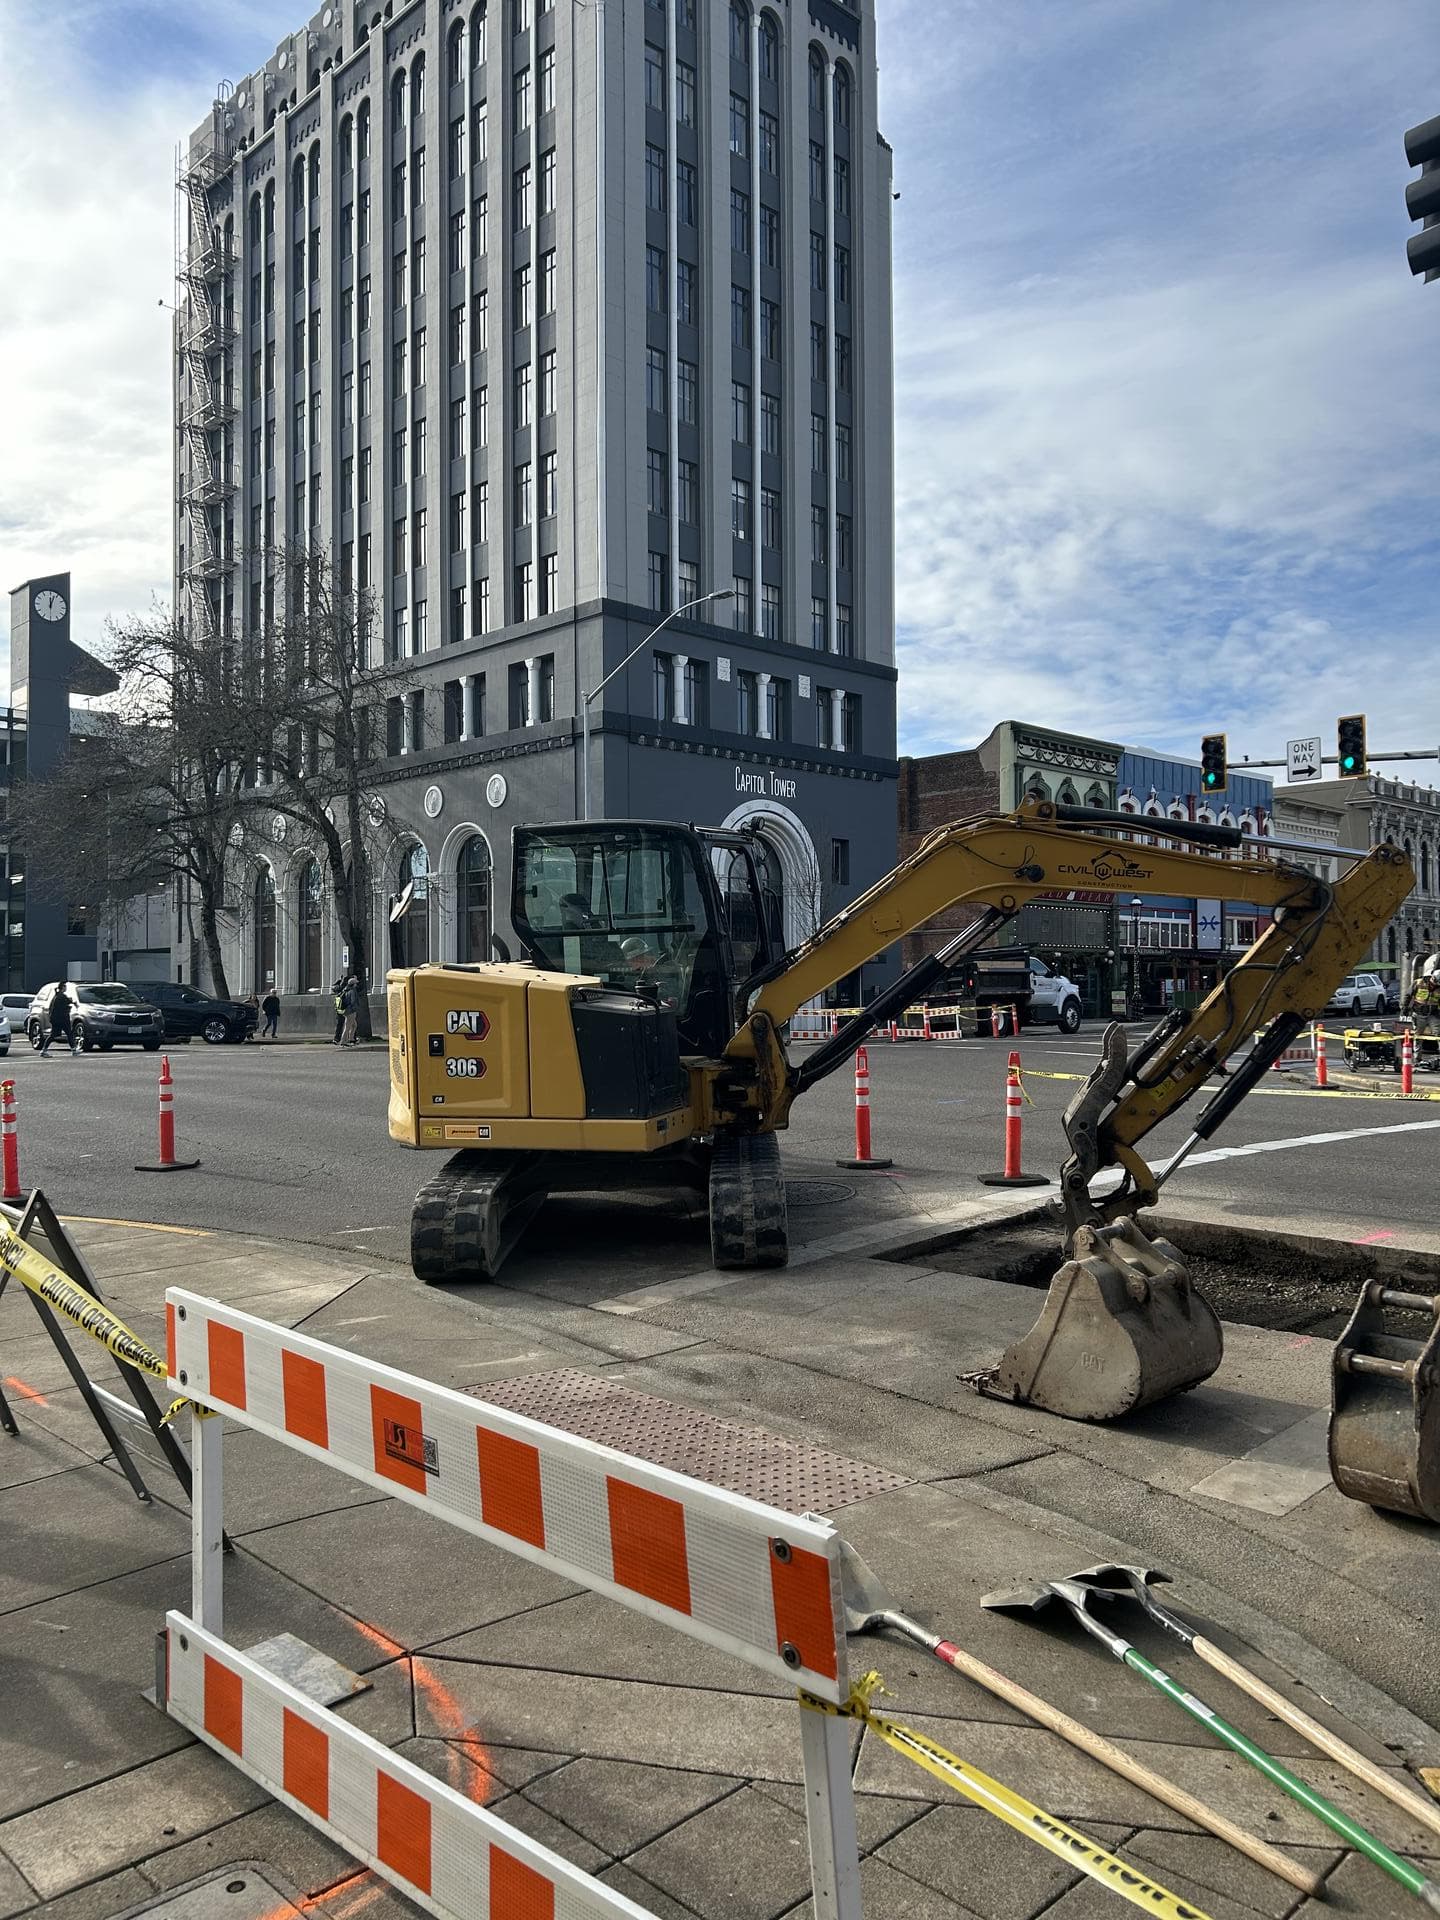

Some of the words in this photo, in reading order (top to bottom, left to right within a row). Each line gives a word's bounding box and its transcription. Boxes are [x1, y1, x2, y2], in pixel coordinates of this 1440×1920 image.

[1293, 741, 1315, 753] ONE
[1293, 752, 1315, 764] WAY
[735, 766, 767, 795] CAPITOL
[769, 770, 796, 798] TOWER
[1058, 864, 1094, 875] CIVIL
[1077, 880, 1133, 889] CONSTRUCTION
[1080, 890, 1111, 902] PEAR
[446, 1010, 480, 1034] CAT
[446, 1058, 478, 1077] 306
[39, 1273, 91, 1321] CAUTION
[81, 1307, 119, 1344] OPEN
[1080, 1351, 1105, 1375] CAT
